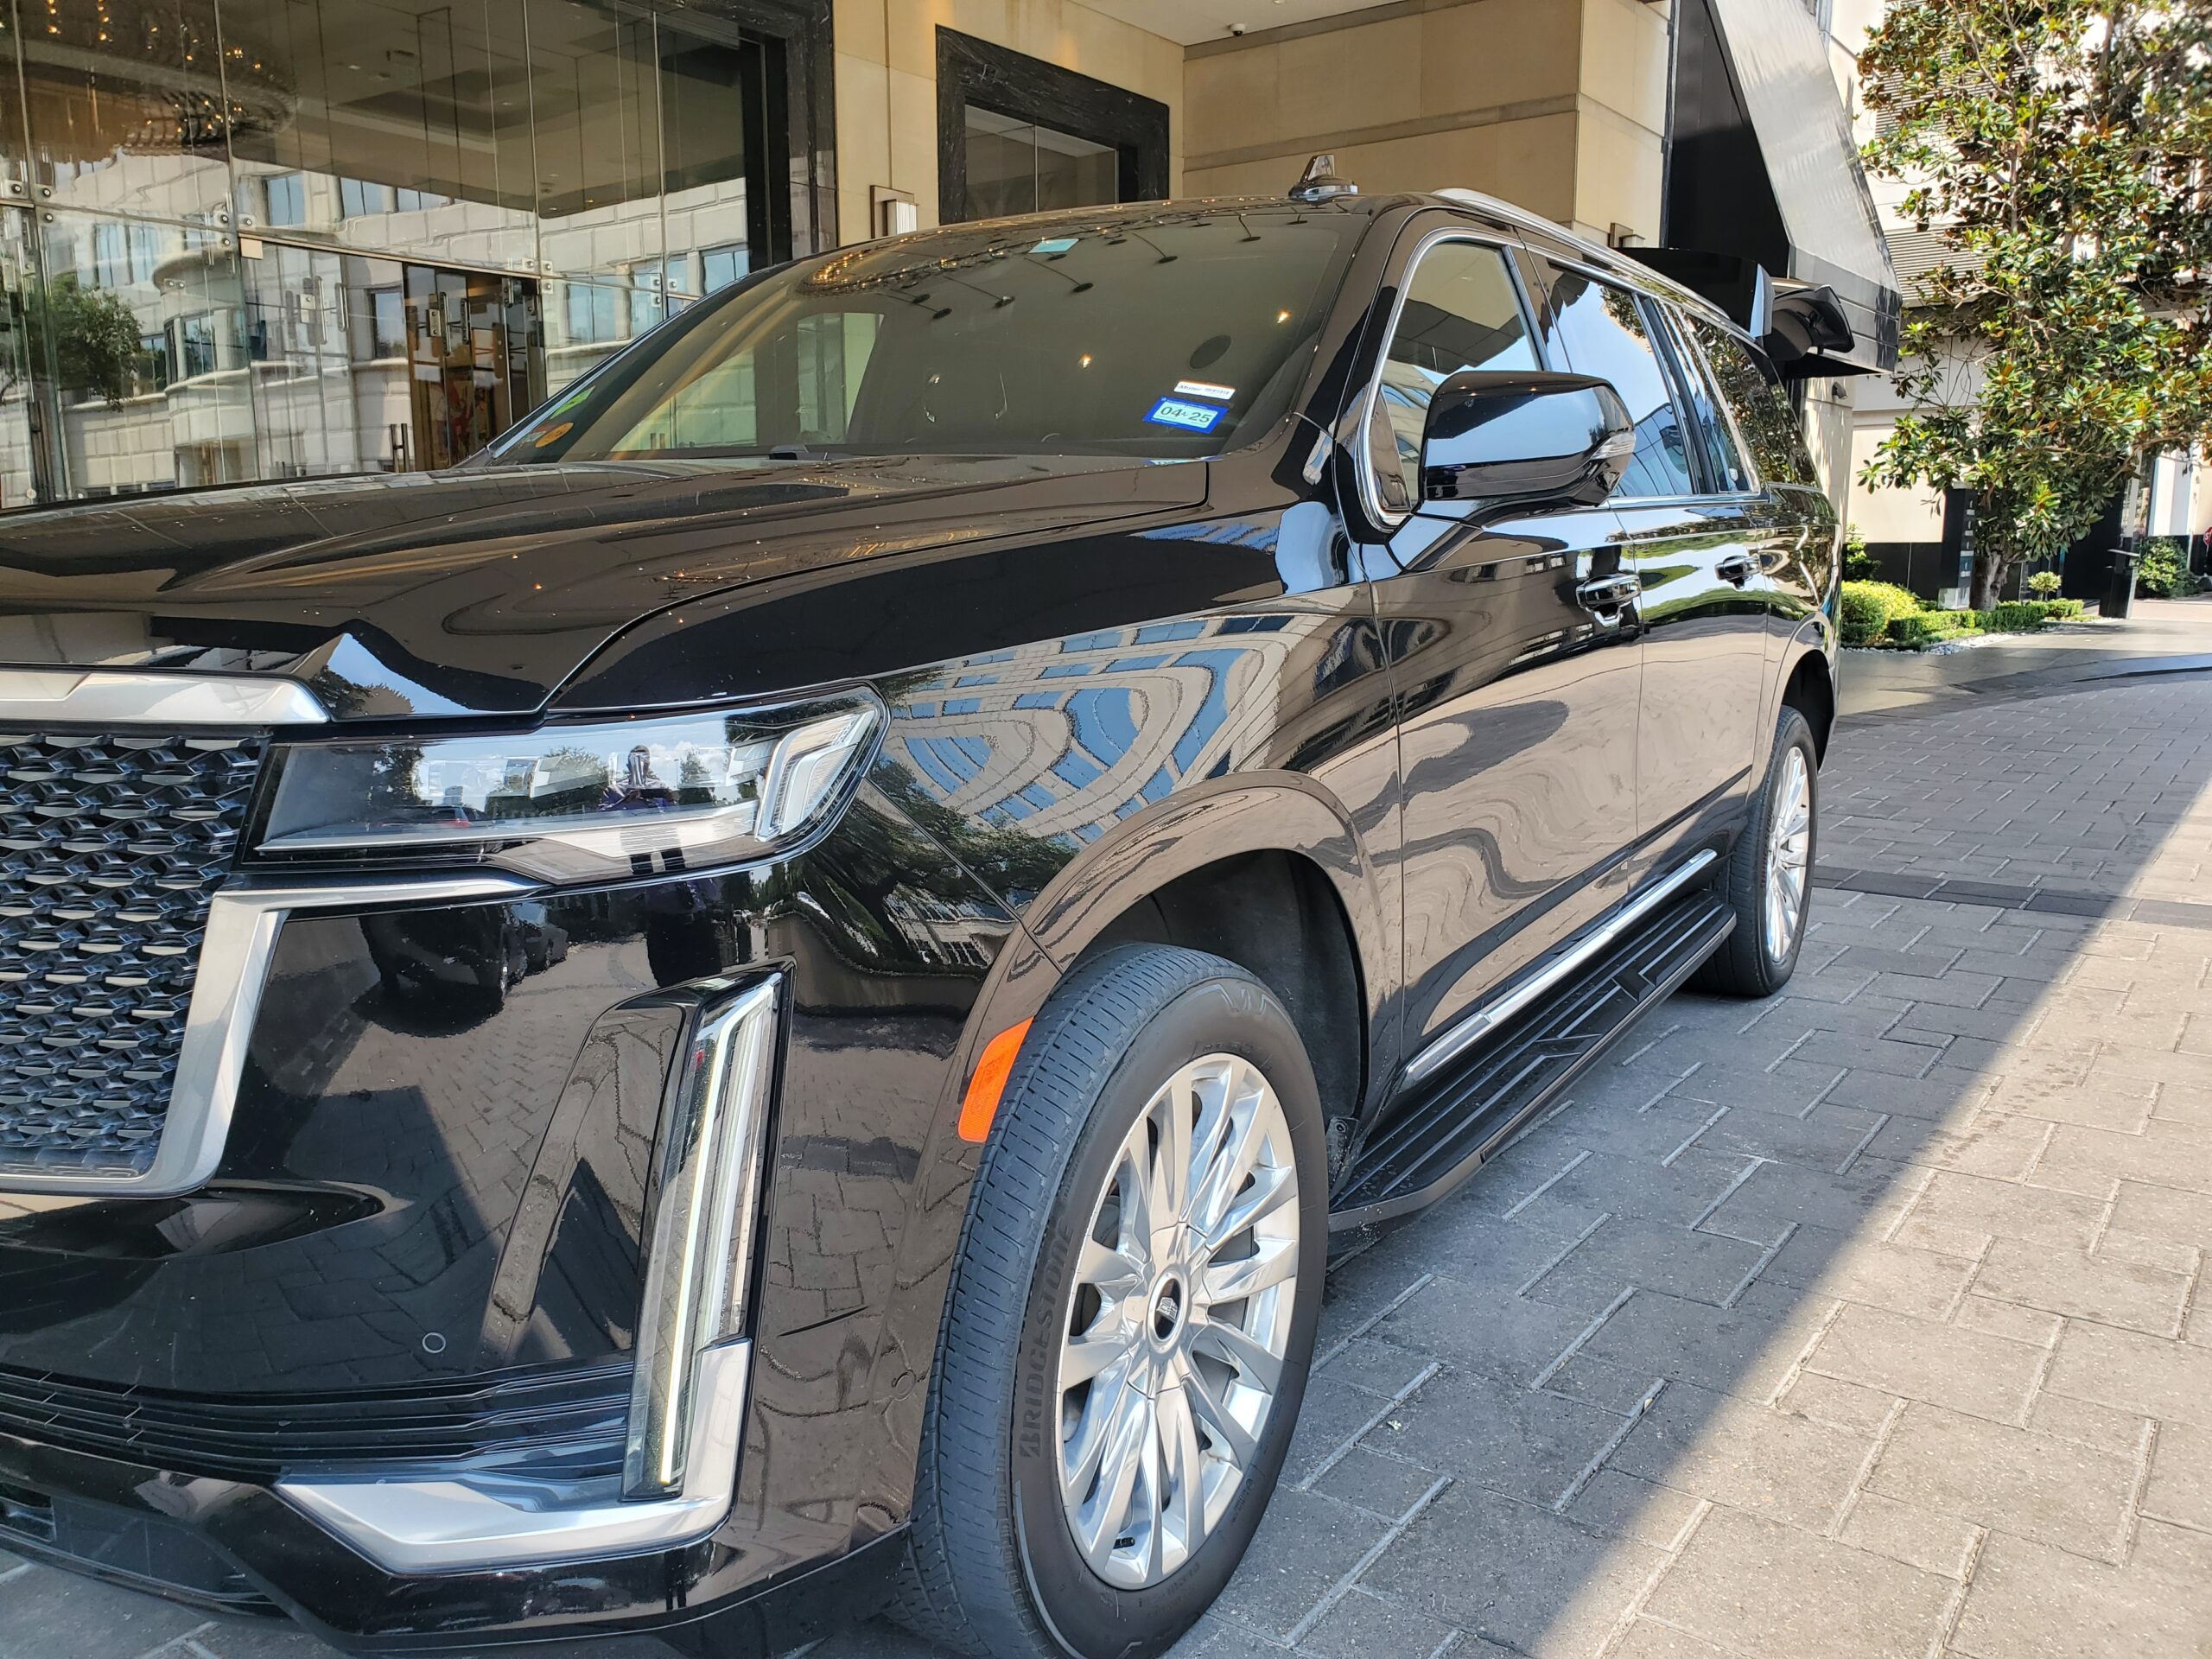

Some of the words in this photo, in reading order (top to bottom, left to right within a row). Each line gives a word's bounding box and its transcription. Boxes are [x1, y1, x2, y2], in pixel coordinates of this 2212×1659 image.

[1160, 406, 1181, 417] 04
[1189, 411, 1211, 423] 25
[1019, 1219, 1075, 1459] BRIDGESTONE
